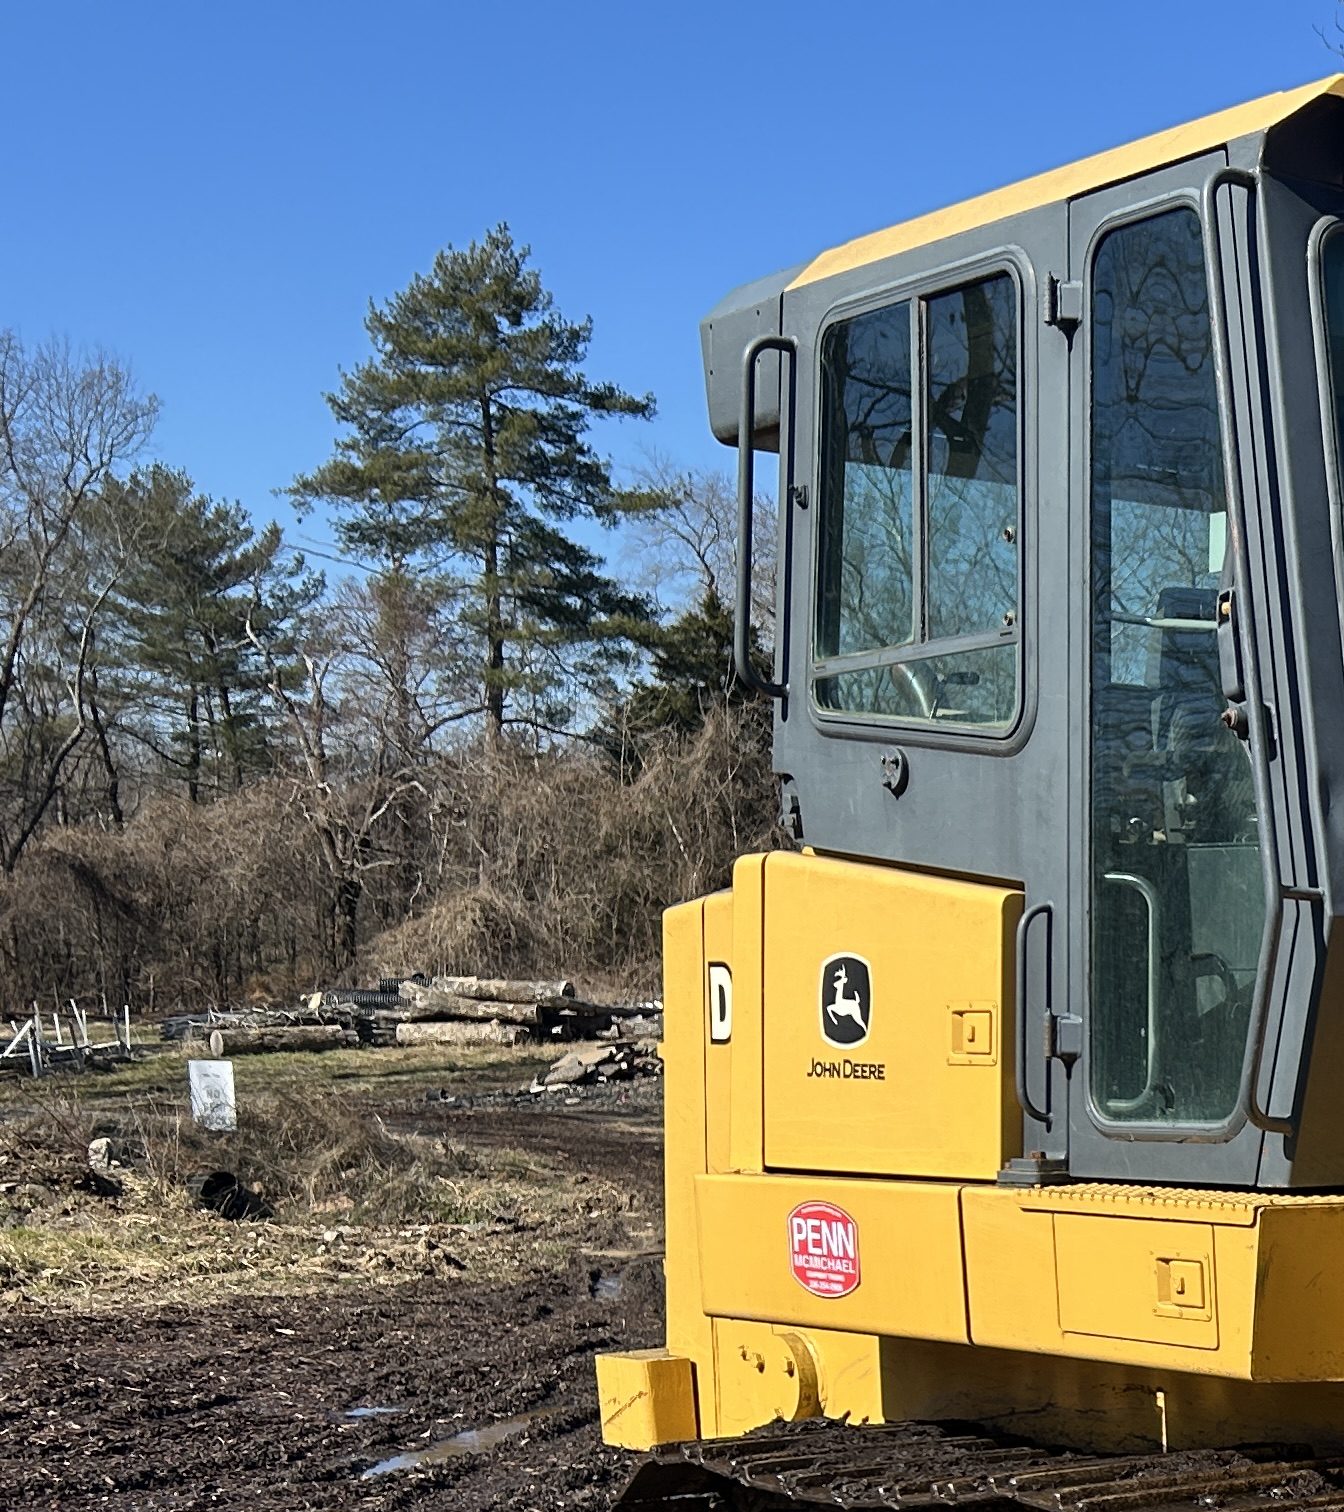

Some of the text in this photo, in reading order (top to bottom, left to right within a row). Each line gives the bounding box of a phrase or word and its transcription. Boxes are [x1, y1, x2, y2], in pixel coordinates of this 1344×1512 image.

[807, 1058, 885, 1080] JOHN DEERE
[792, 1217, 855, 1259] PENN
